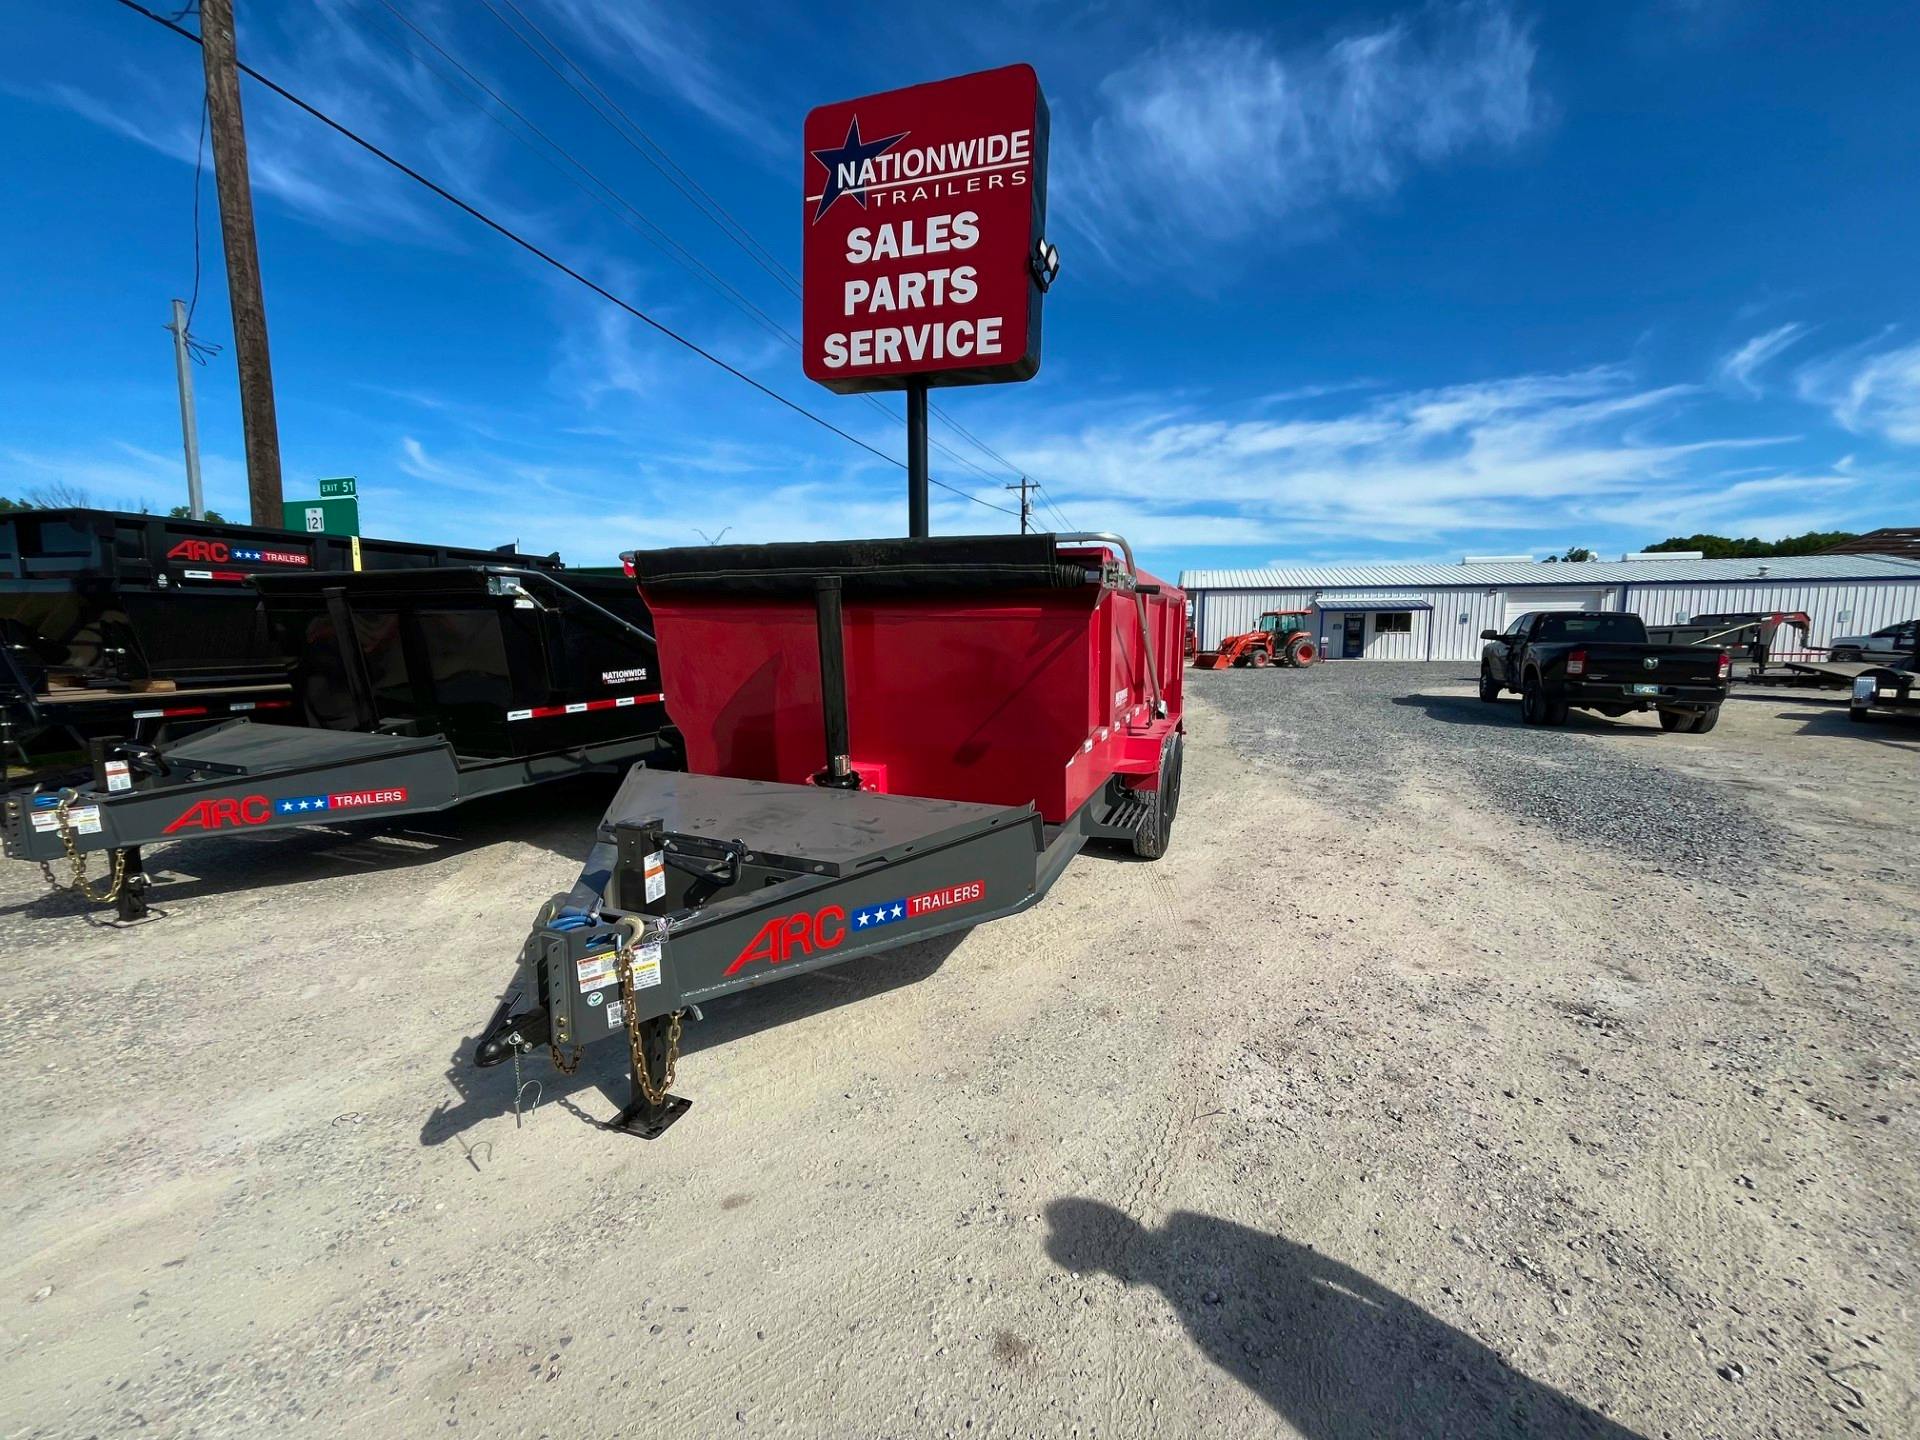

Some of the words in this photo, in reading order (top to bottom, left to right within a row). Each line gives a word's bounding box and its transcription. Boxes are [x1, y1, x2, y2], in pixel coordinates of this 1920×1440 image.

[837, 129, 1030, 189] NATIONWIDE
[872, 170, 1027, 207] TRAILERS
[845, 211, 980, 264] SALES
[844, 265, 978, 316] PARTS
[823, 317, 1003, 369] SERVICE
[321, 483, 338, 493] EXIT
[342, 481, 354, 493] 51
[307, 516, 323, 530] 121
[167, 540, 230, 563] ARC
[265, 552, 307, 564] TRAILERS
[602, 668, 647, 681] NATIONWIDE
[160, 795, 272, 834] ARC
[334, 791, 402, 807] TRAILERS
[723, 904, 845, 976] ARC
[912, 883, 980, 913] TRAILERS
